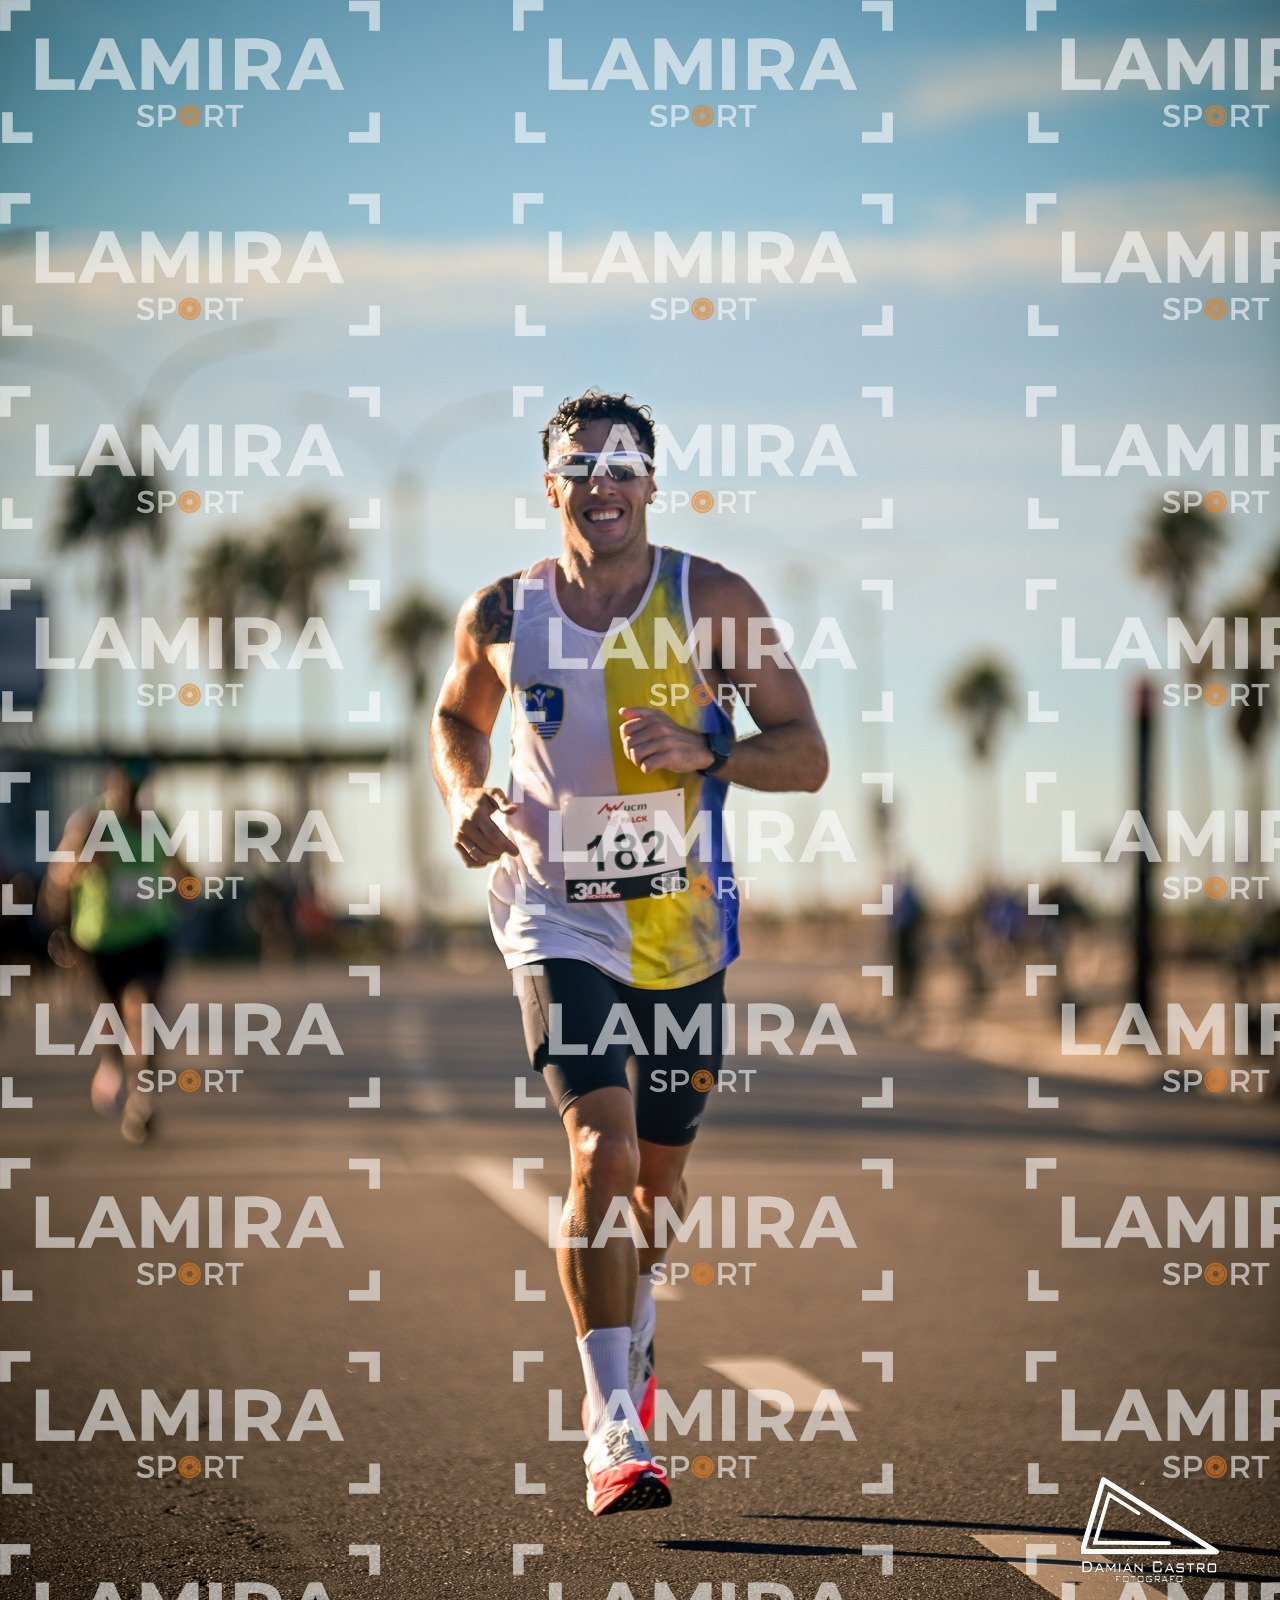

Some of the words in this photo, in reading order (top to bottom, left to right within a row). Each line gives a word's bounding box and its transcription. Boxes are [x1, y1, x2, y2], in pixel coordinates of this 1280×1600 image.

[623, 803, 648, 812] ucm
[587, 830, 666, 872] 182
[574, 881, 616, 900] 30K
